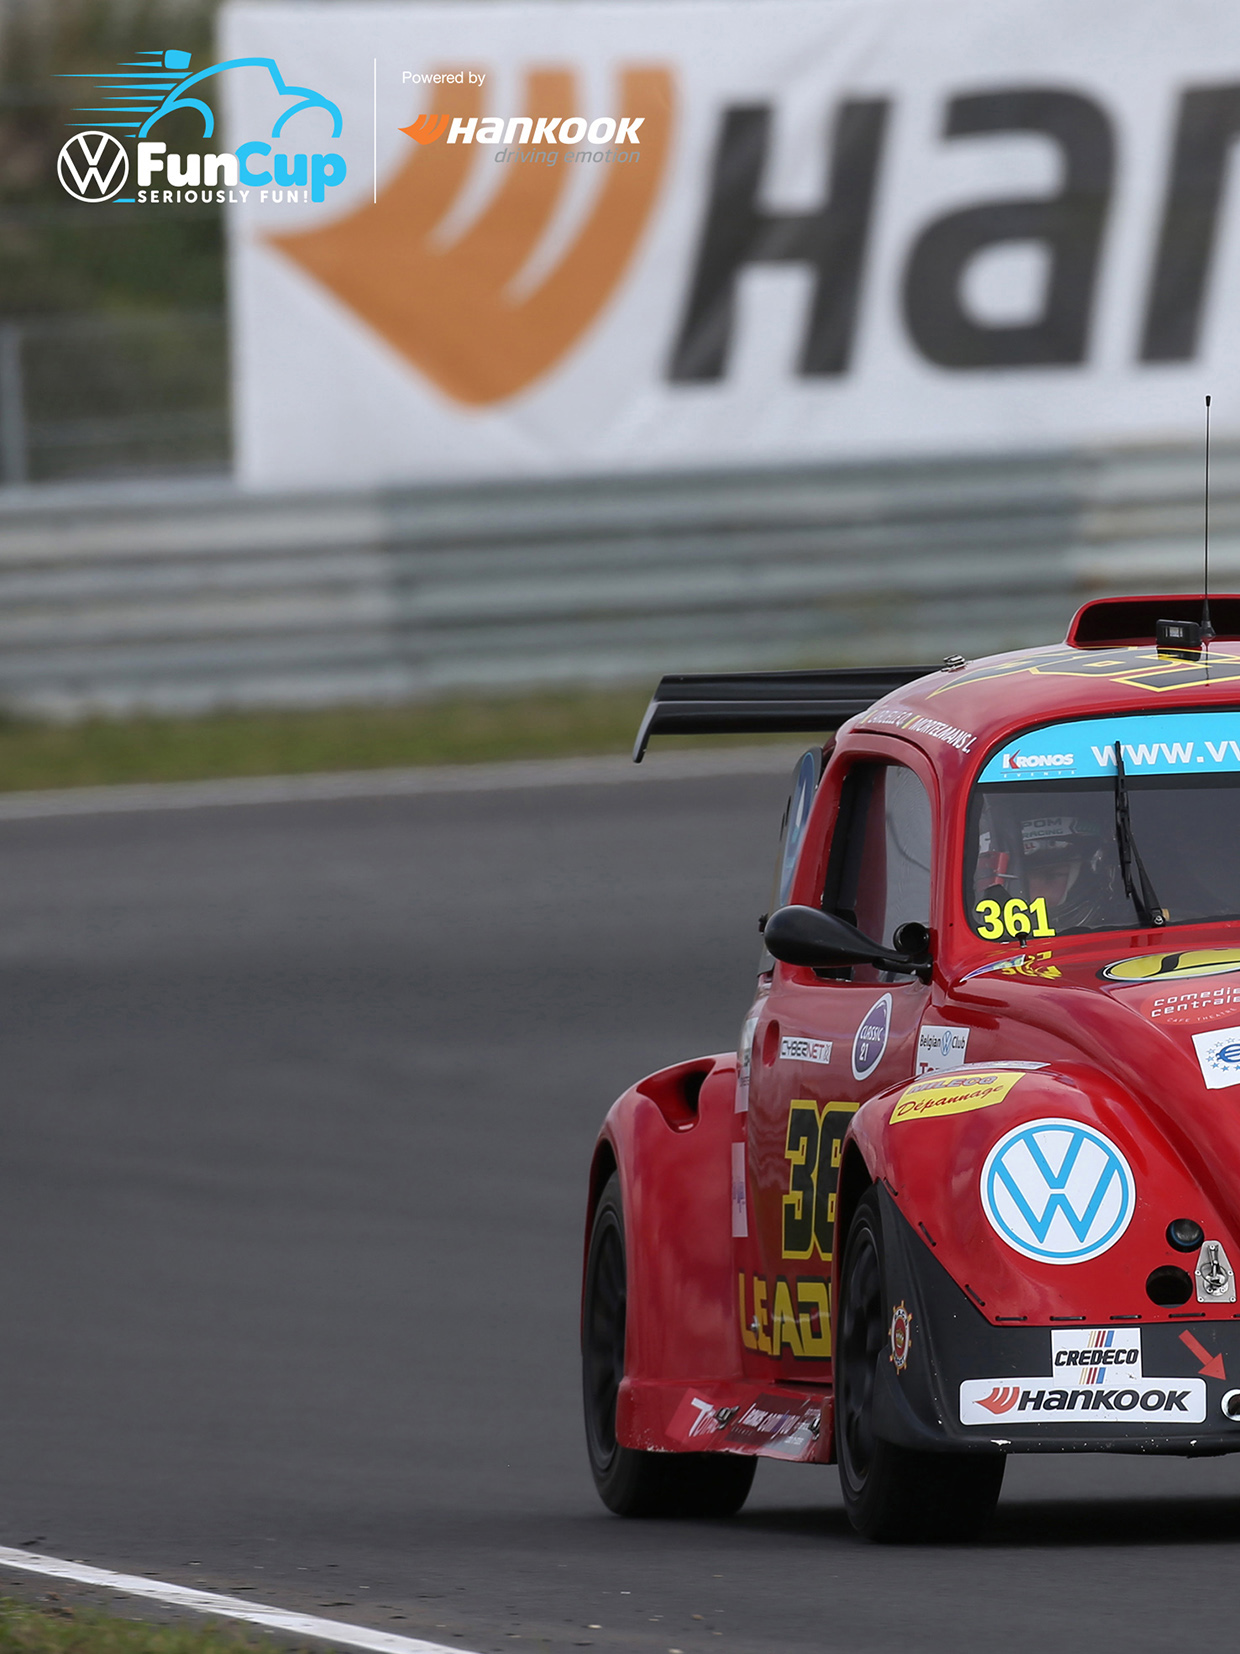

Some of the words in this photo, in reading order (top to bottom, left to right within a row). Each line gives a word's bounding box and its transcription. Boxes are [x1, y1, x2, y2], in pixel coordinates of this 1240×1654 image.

[1002, 749, 1075, 769] KRONOS
[976, 897, 1056, 941] 361
[782, 1040, 825, 1059] CYBERNET
[859, 1042, 870, 1062] 21
[919, 1034, 941, 1051] Belgian
[897, 1085, 1004, 1117] Dépannage
[738, 1268, 833, 1361] LEAD
[1054, 1348, 1138, 1366] CREDECO
